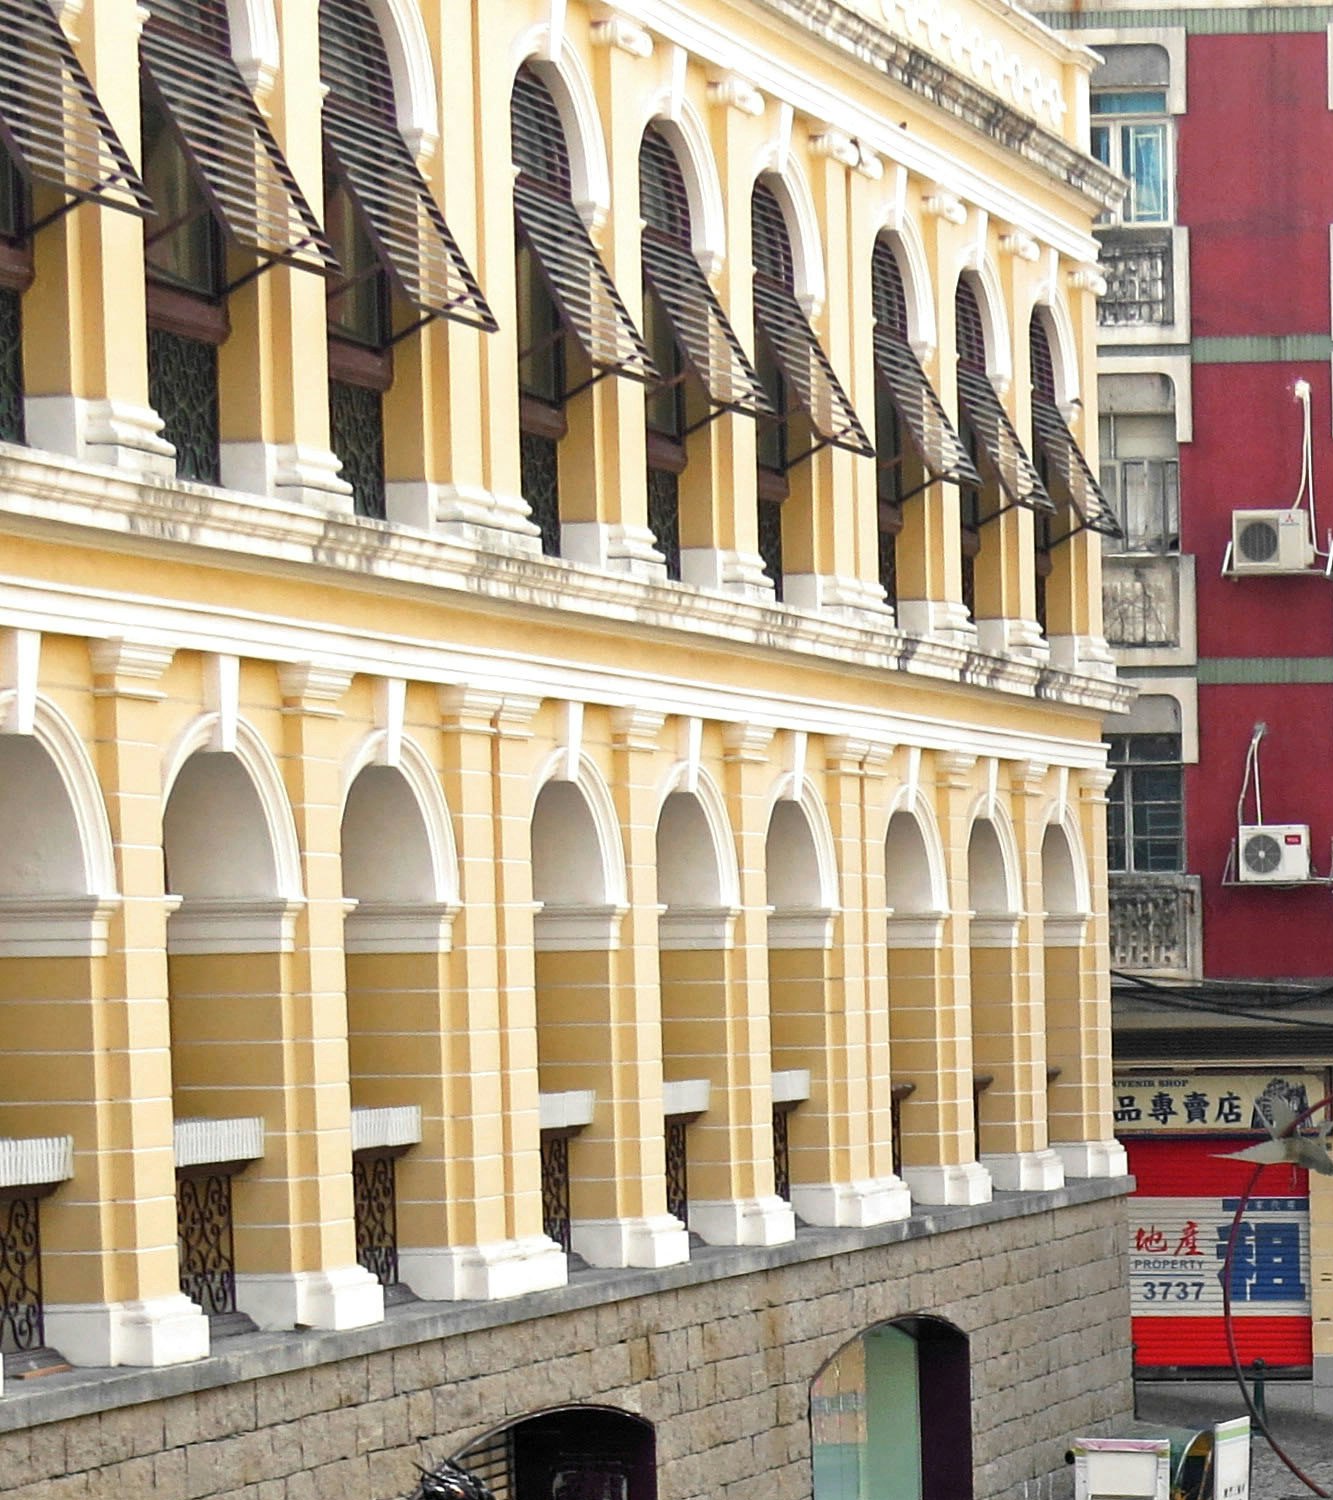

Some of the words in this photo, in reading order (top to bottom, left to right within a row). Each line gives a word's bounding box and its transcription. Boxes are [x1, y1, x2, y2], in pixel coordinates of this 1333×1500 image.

[1158, 1080, 1188, 1088] SHOP
[1113, 1091, 1242, 1124] 品專賣店
[1135, 1220, 1205, 1256] 地產
[1134, 1259, 1205, 1269] PROPERTY
[1143, 1281, 1205, 1300] 3737
